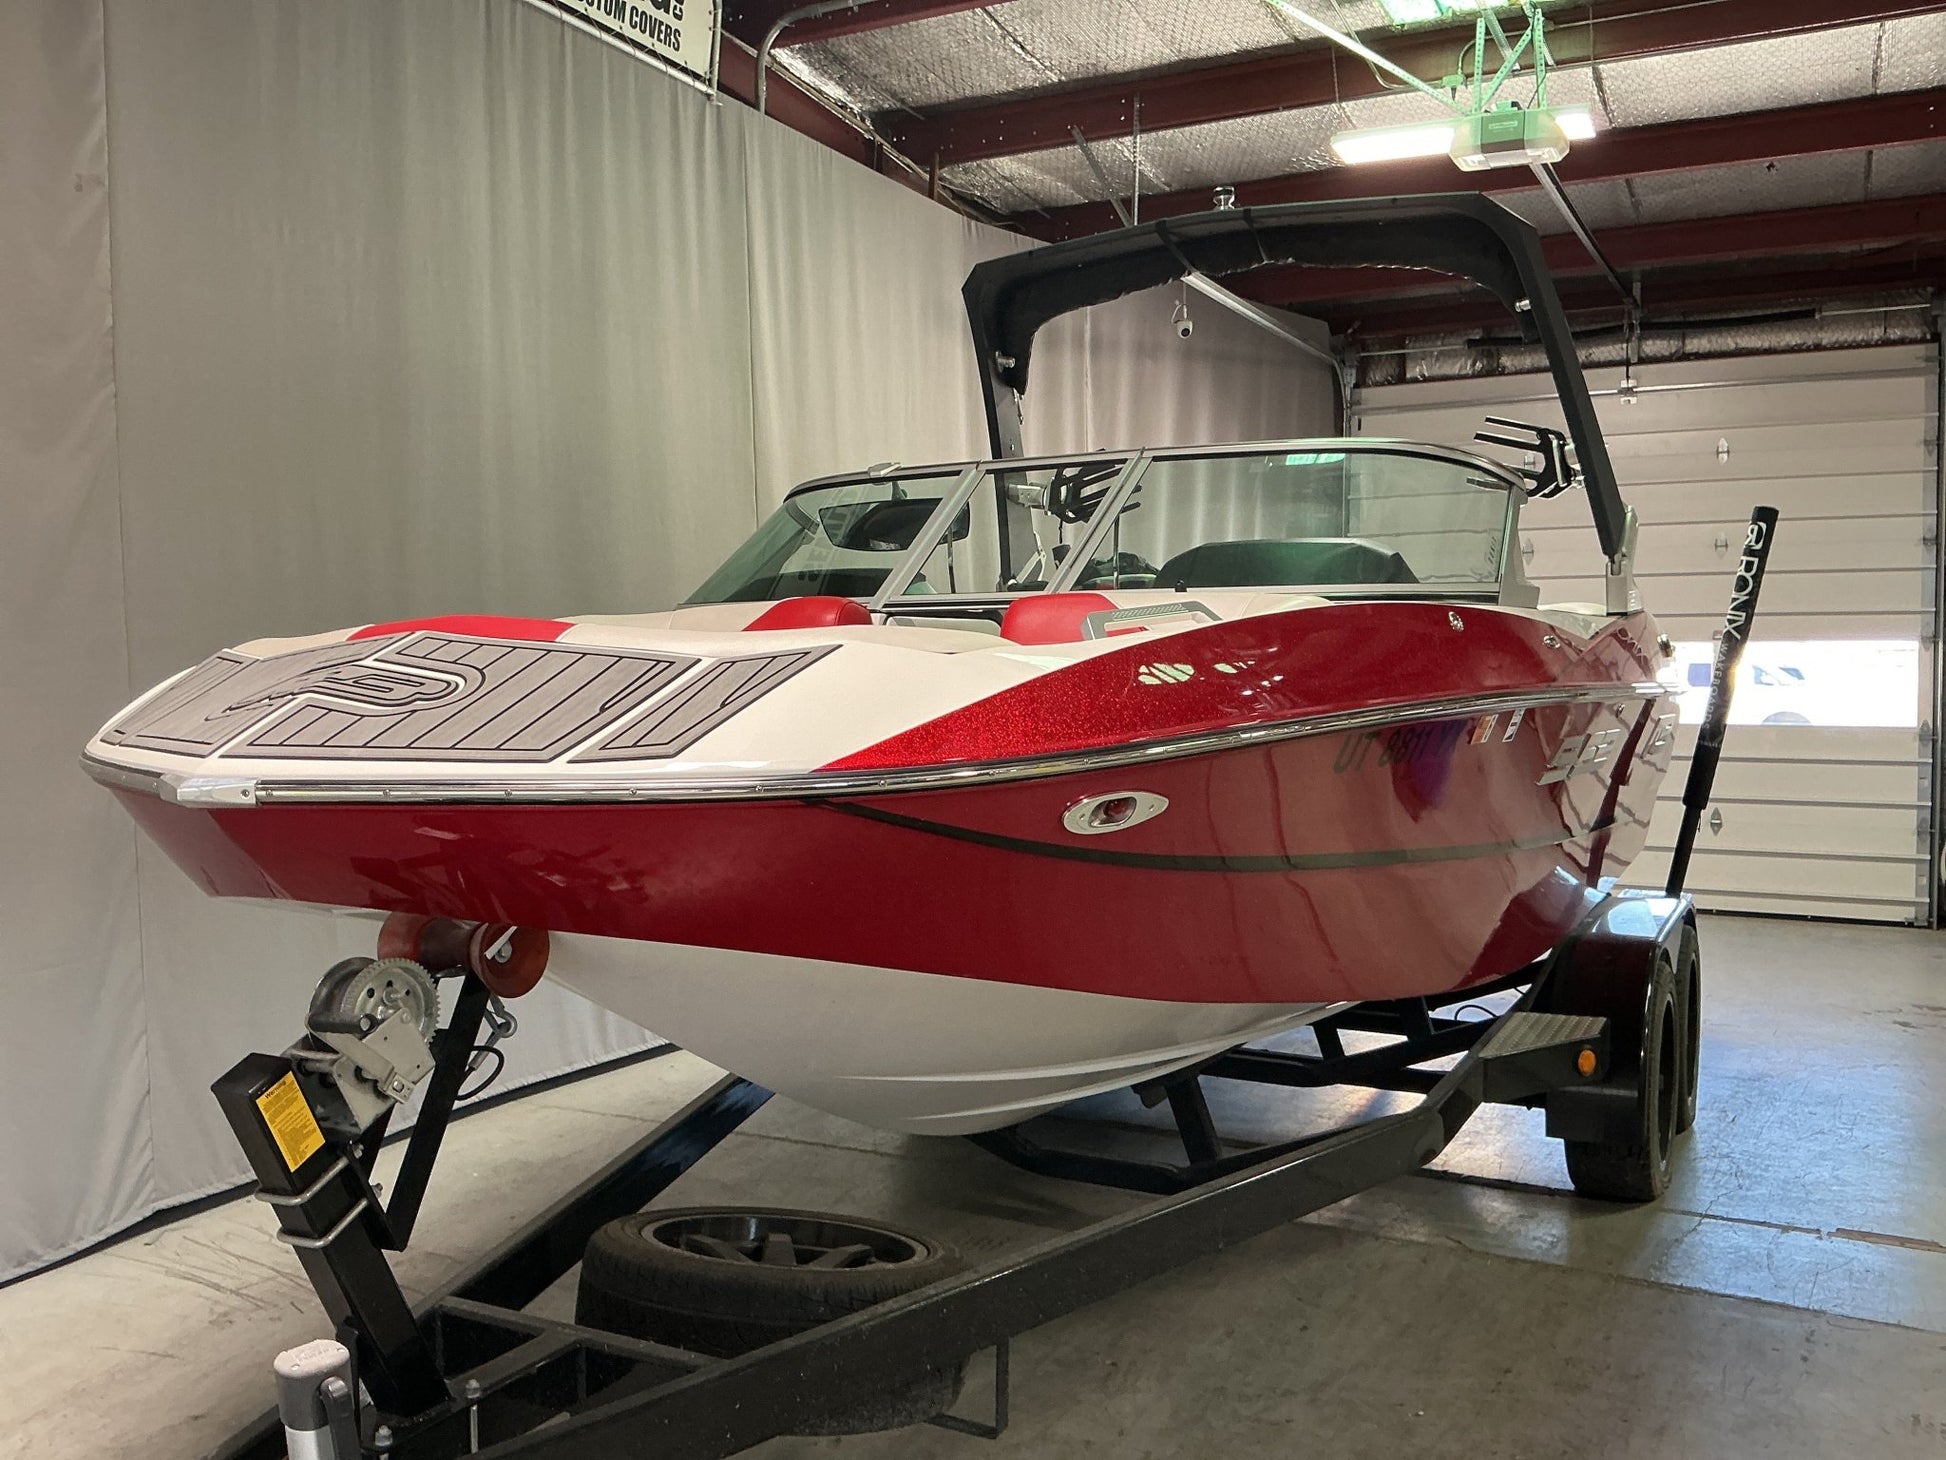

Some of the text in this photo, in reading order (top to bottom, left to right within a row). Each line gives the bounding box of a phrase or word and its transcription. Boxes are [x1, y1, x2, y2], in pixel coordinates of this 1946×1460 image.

[629, 5, 681, 52] COVERS
[1723, 556, 1759, 641] RONIX
[1334, 730, 1380, 773] UT
